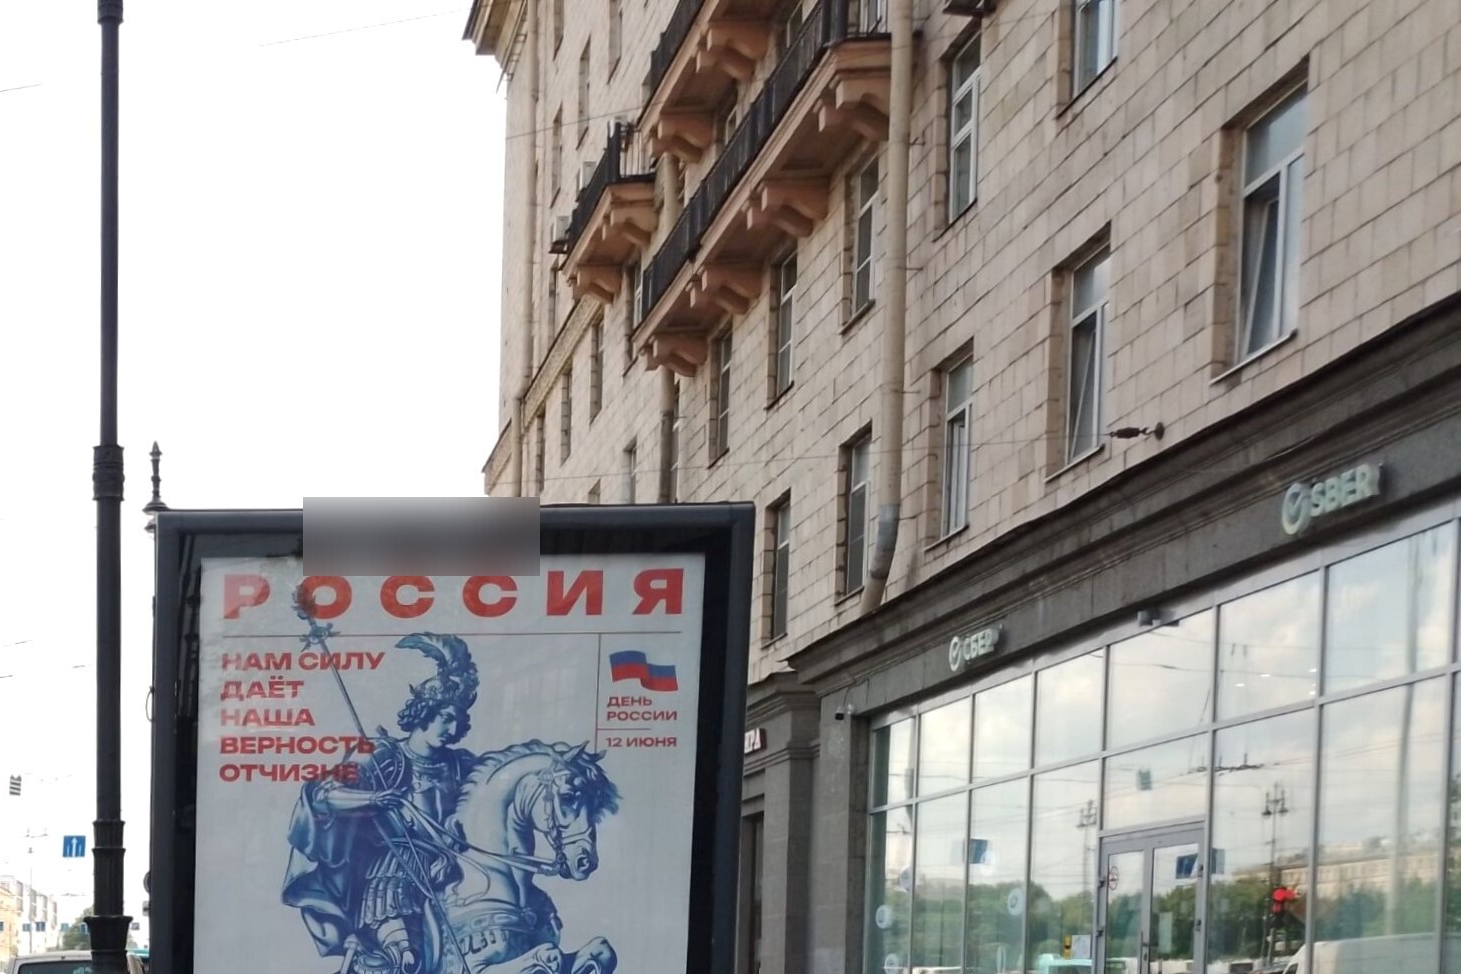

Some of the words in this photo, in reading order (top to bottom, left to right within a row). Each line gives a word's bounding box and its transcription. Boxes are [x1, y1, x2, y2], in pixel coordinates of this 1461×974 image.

[1311, 464, 1380, 517] SBER
[223, 568, 684, 620] РОССИЯ
[963, 628, 999, 661] СБЕР
[221, 652, 292, 671] НАМ
[298, 651, 386, 671] СИЛУ
[220, 675, 304, 701] ДАЁТ
[607, 696, 653, 708] ДЕНЬ
[220, 708, 316, 727] НАША
[606, 710, 678, 722] РОССИИ
[220, 736, 376, 755] ВЕРНОСТЬ
[605, 737, 623, 748] 12
[626, 737, 678, 748] ИЮНЯ
[219, 763, 361, 783] ОТЧИЗНЕ
